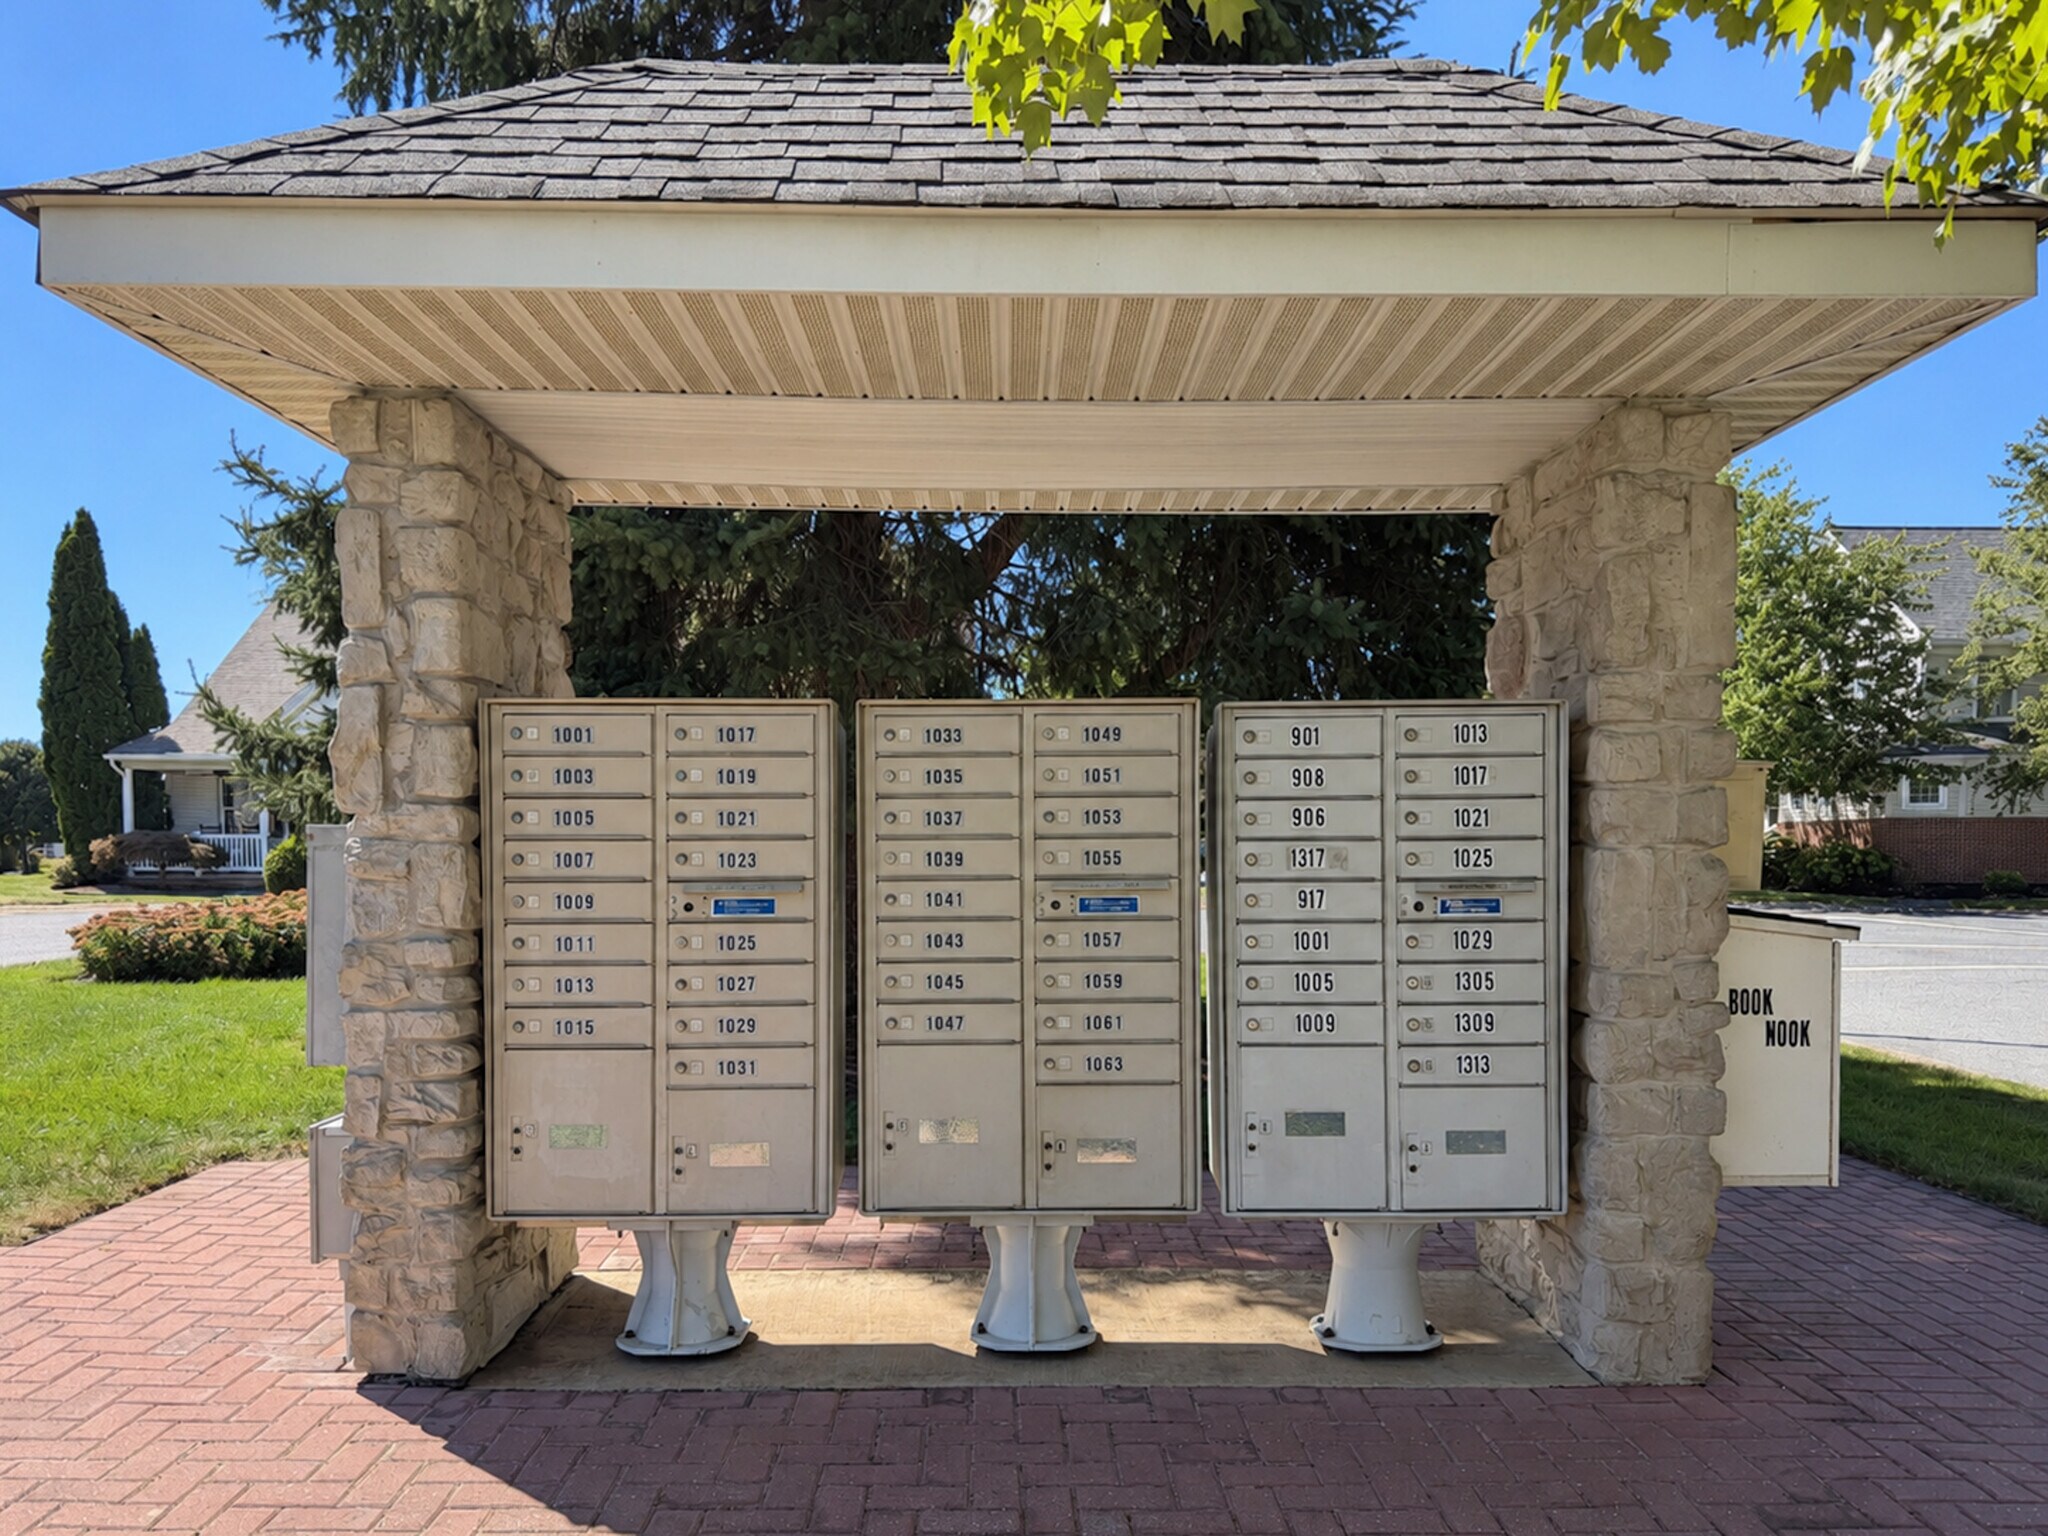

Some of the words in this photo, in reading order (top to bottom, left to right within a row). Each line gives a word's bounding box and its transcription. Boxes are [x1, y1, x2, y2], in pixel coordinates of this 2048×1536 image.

[554, 727, 591, 743] 1001
[718, 726, 755, 743] 1017
[925, 727, 962, 744] 1033
[1084, 726, 1121, 743] 1049
[1291, 726, 1319, 746] 901
[1454, 723, 1488, 744] 1013
[555, 768, 593, 785] 1003
[717, 768, 756, 785] 1019
[926, 768, 963, 785] 1035
[1084, 767, 1120, 783] 1051
[1292, 768, 1324, 787] 908
[1454, 765, 1487, 786] 1017
[554, 809, 594, 826] 1005
[718, 811, 755, 827] 1021
[925, 810, 962, 826] 1037
[1084, 809, 1122, 825] 1053
[1292, 807, 1325, 827] 906
[1454, 808, 1489, 828] 1021
[555, 852, 593, 869] 1007
[719, 852, 757, 869] 1023
[926, 851, 964, 867] 1039
[1084, 850, 1122, 866] 1055
[1291, 848, 1325, 868] 1317
[1453, 848, 1493, 868] 1025
[556, 894, 594, 910] 1009
[926, 892, 962, 907] 1041
[1298, 889, 1325, 909] 917
[556, 936, 593, 953] 1011
[718, 935, 756, 951] 1025
[926, 933, 964, 949] 1043
[1084, 931, 1121, 948] 1057
[1294, 931, 1329, 951] 1001
[1453, 929, 1492, 950] 1029
[556, 977, 594, 994] 1013
[718, 976, 755, 992] 1027
[926, 974, 964, 990] 1045
[1085, 973, 1123, 989] 1059
[1294, 972, 1334, 992] 1005
[1455, 971, 1494, 991] 1305
[1728, 988, 1774, 1016] BOOK
[556, 1019, 594, 1036] 1015
[718, 1017, 756, 1034] 1029
[927, 1015, 964, 1031] 1047
[1085, 1015, 1121, 1031] 1061
[1296, 1013, 1335, 1033] 1009
[1455, 1012, 1494, 1033] 1309
[1765, 1019, 1811, 1048] NOOK
[718, 1060, 755, 1076] 1031
[1086, 1056, 1123, 1072] 1063
[1456, 1054, 1490, 1074] 1313
